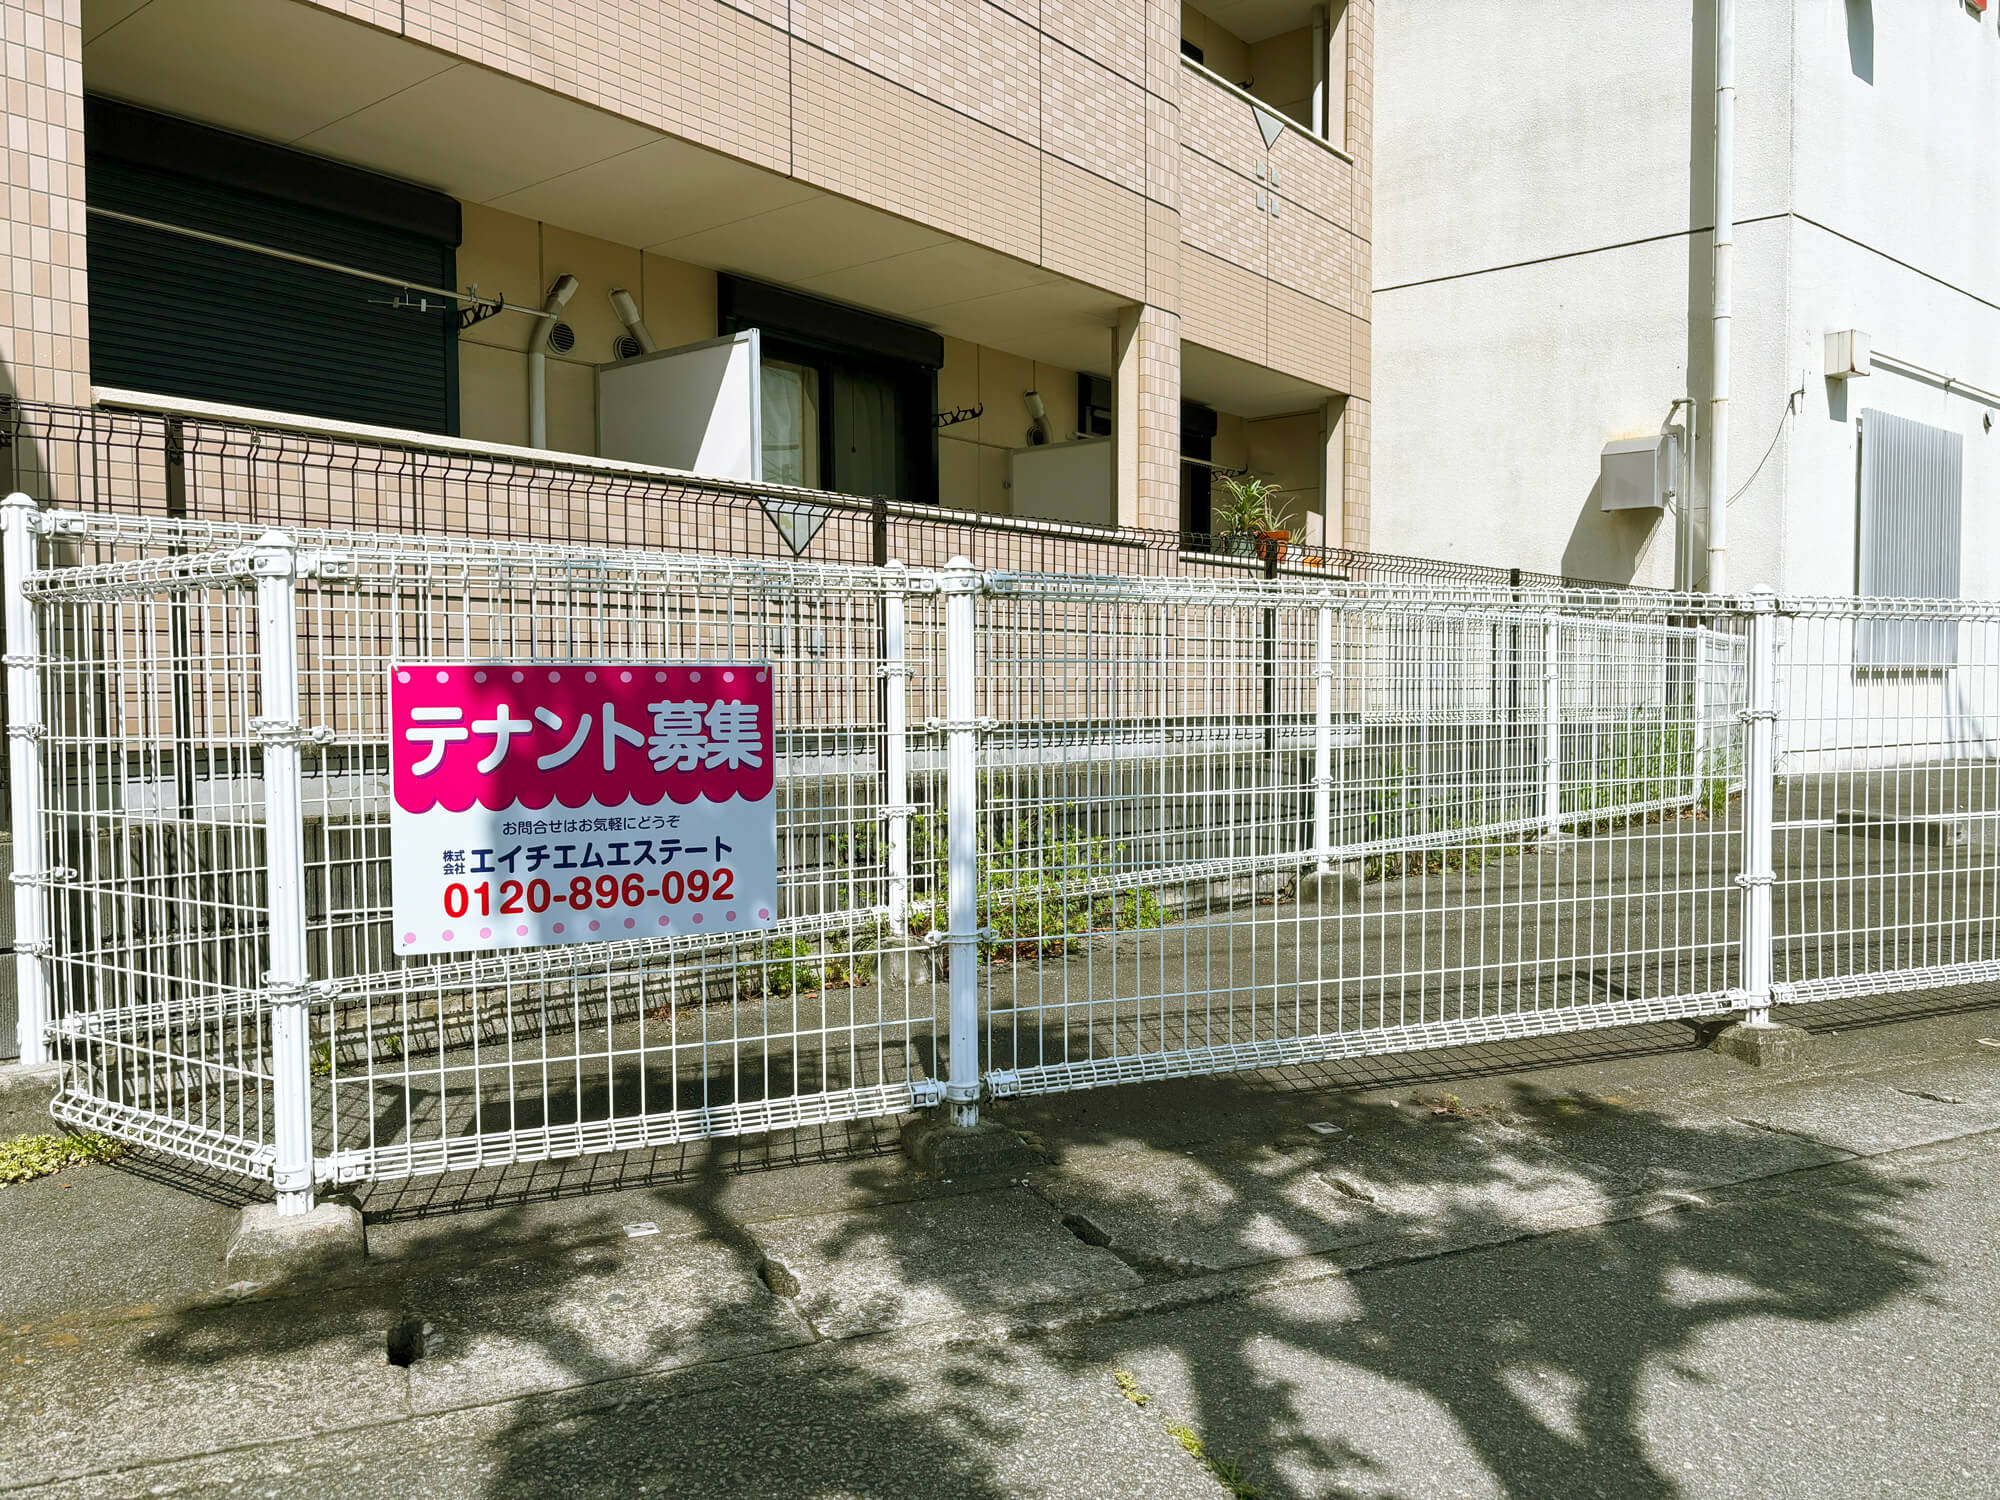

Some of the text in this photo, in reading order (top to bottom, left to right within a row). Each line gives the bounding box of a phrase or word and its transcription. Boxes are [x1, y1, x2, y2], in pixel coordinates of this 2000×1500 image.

[405, 699, 763, 776] テナント募集
[503, 815, 680, 836] お問合せはお気軽にどうぞ
[443, 849, 465, 862] 株式
[443, 863, 465, 875] 会社
[471, 836, 732, 873] エイチエムエステート
[443, 868, 734, 918] 0120-896-092
